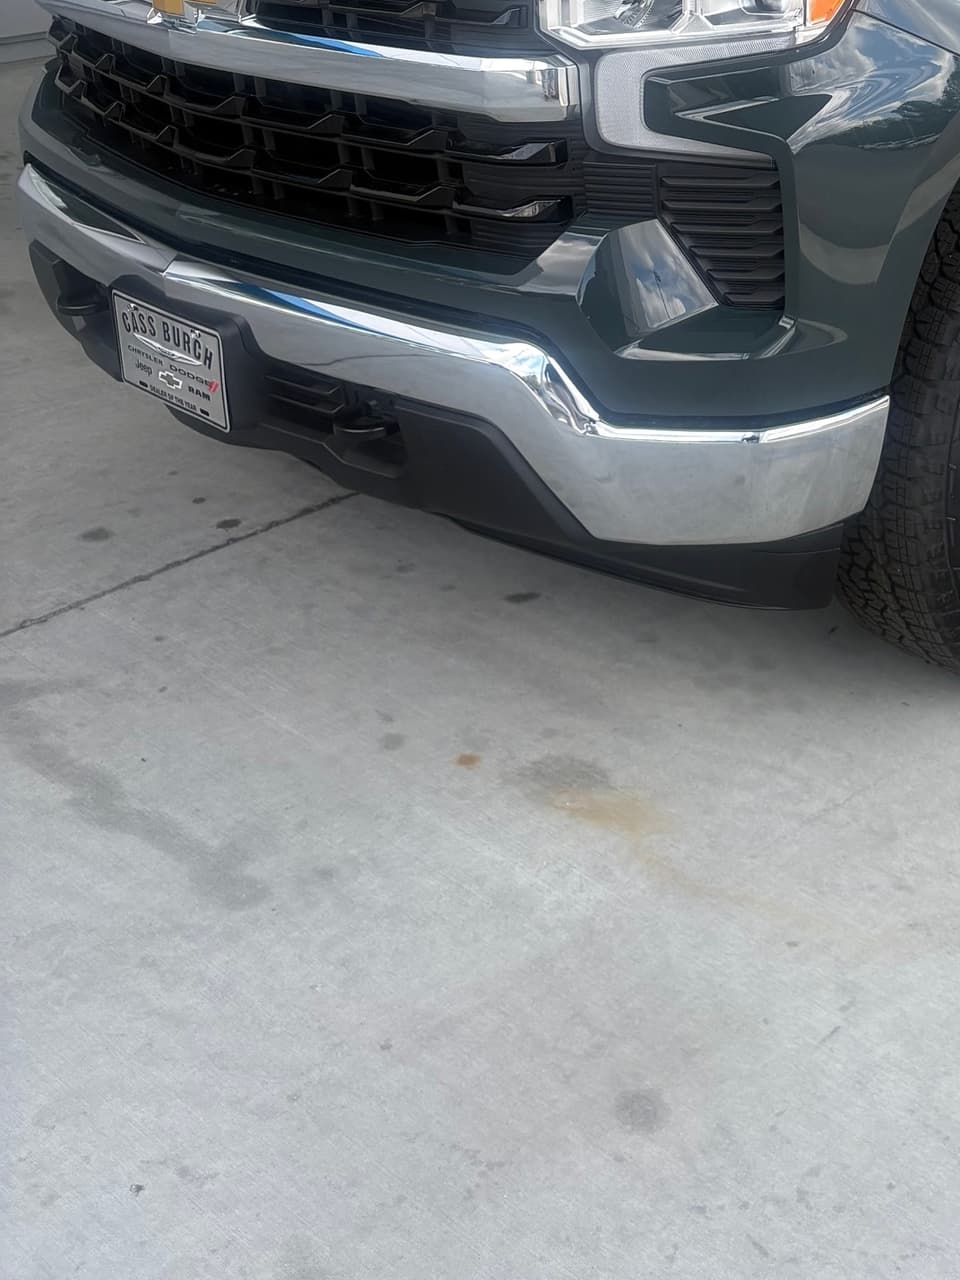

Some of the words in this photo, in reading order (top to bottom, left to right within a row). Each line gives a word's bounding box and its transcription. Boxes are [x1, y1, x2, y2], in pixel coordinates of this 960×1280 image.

[121, 312, 157, 337] CASS
[162, 321, 213, 370] BURCH
[127, 344, 163, 366] CHRYSLER
[135, 359, 153, 377] Jeep
[169, 364, 211, 387] DODGE
[188, 385, 211, 402] RAM
[184, 399, 197, 412] YEAR
